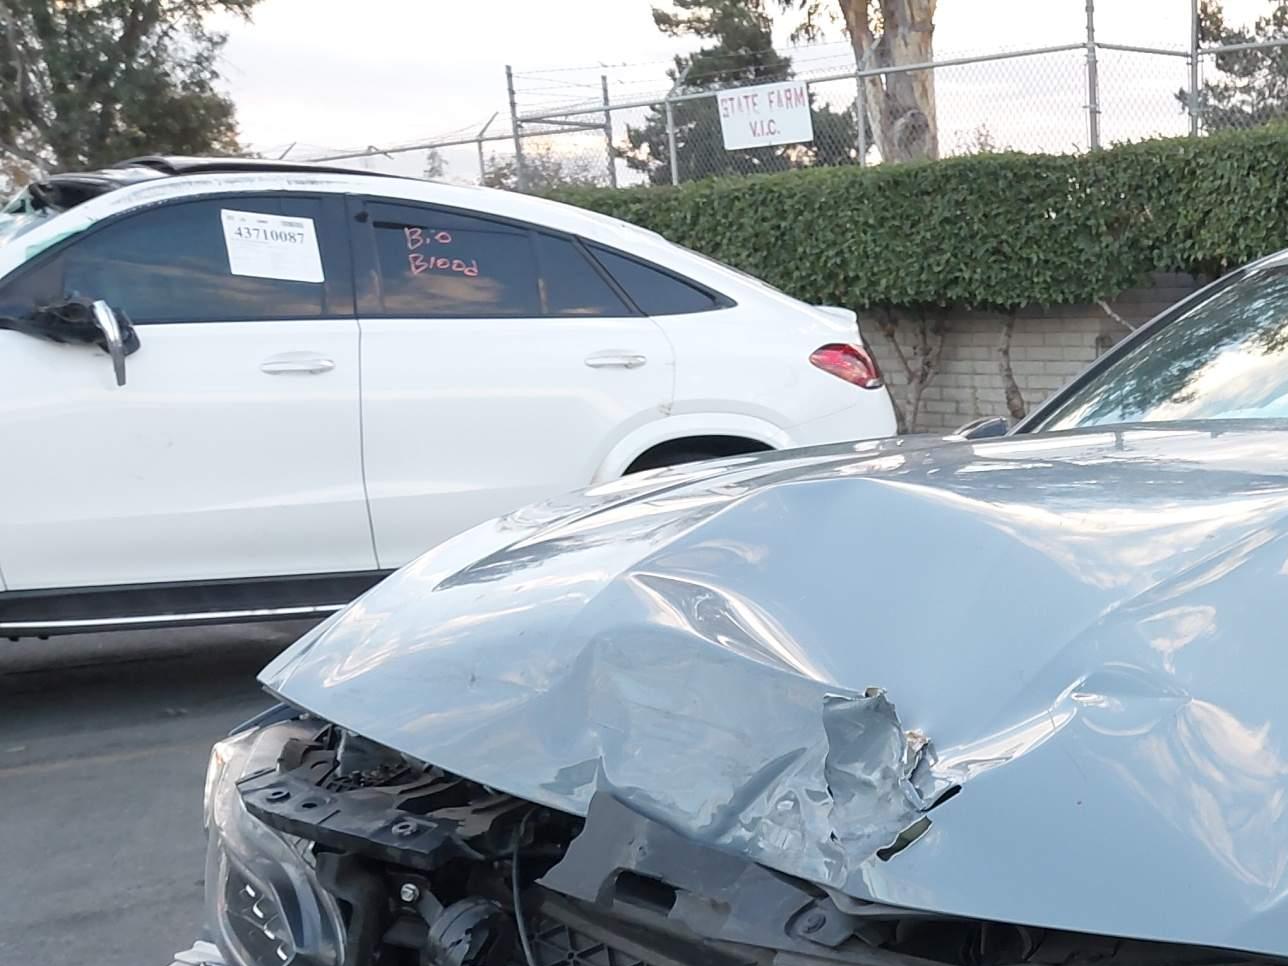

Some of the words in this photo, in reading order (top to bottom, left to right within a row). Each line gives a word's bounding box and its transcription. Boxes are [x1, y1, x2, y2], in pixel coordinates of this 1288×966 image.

[720, 93, 759, 119] STATE
[768, 87, 806, 110] FARM
[749, 119, 781, 138] V.I.C.
[233, 226, 305, 244] 43710087
[408, 253, 479, 277] Blood
